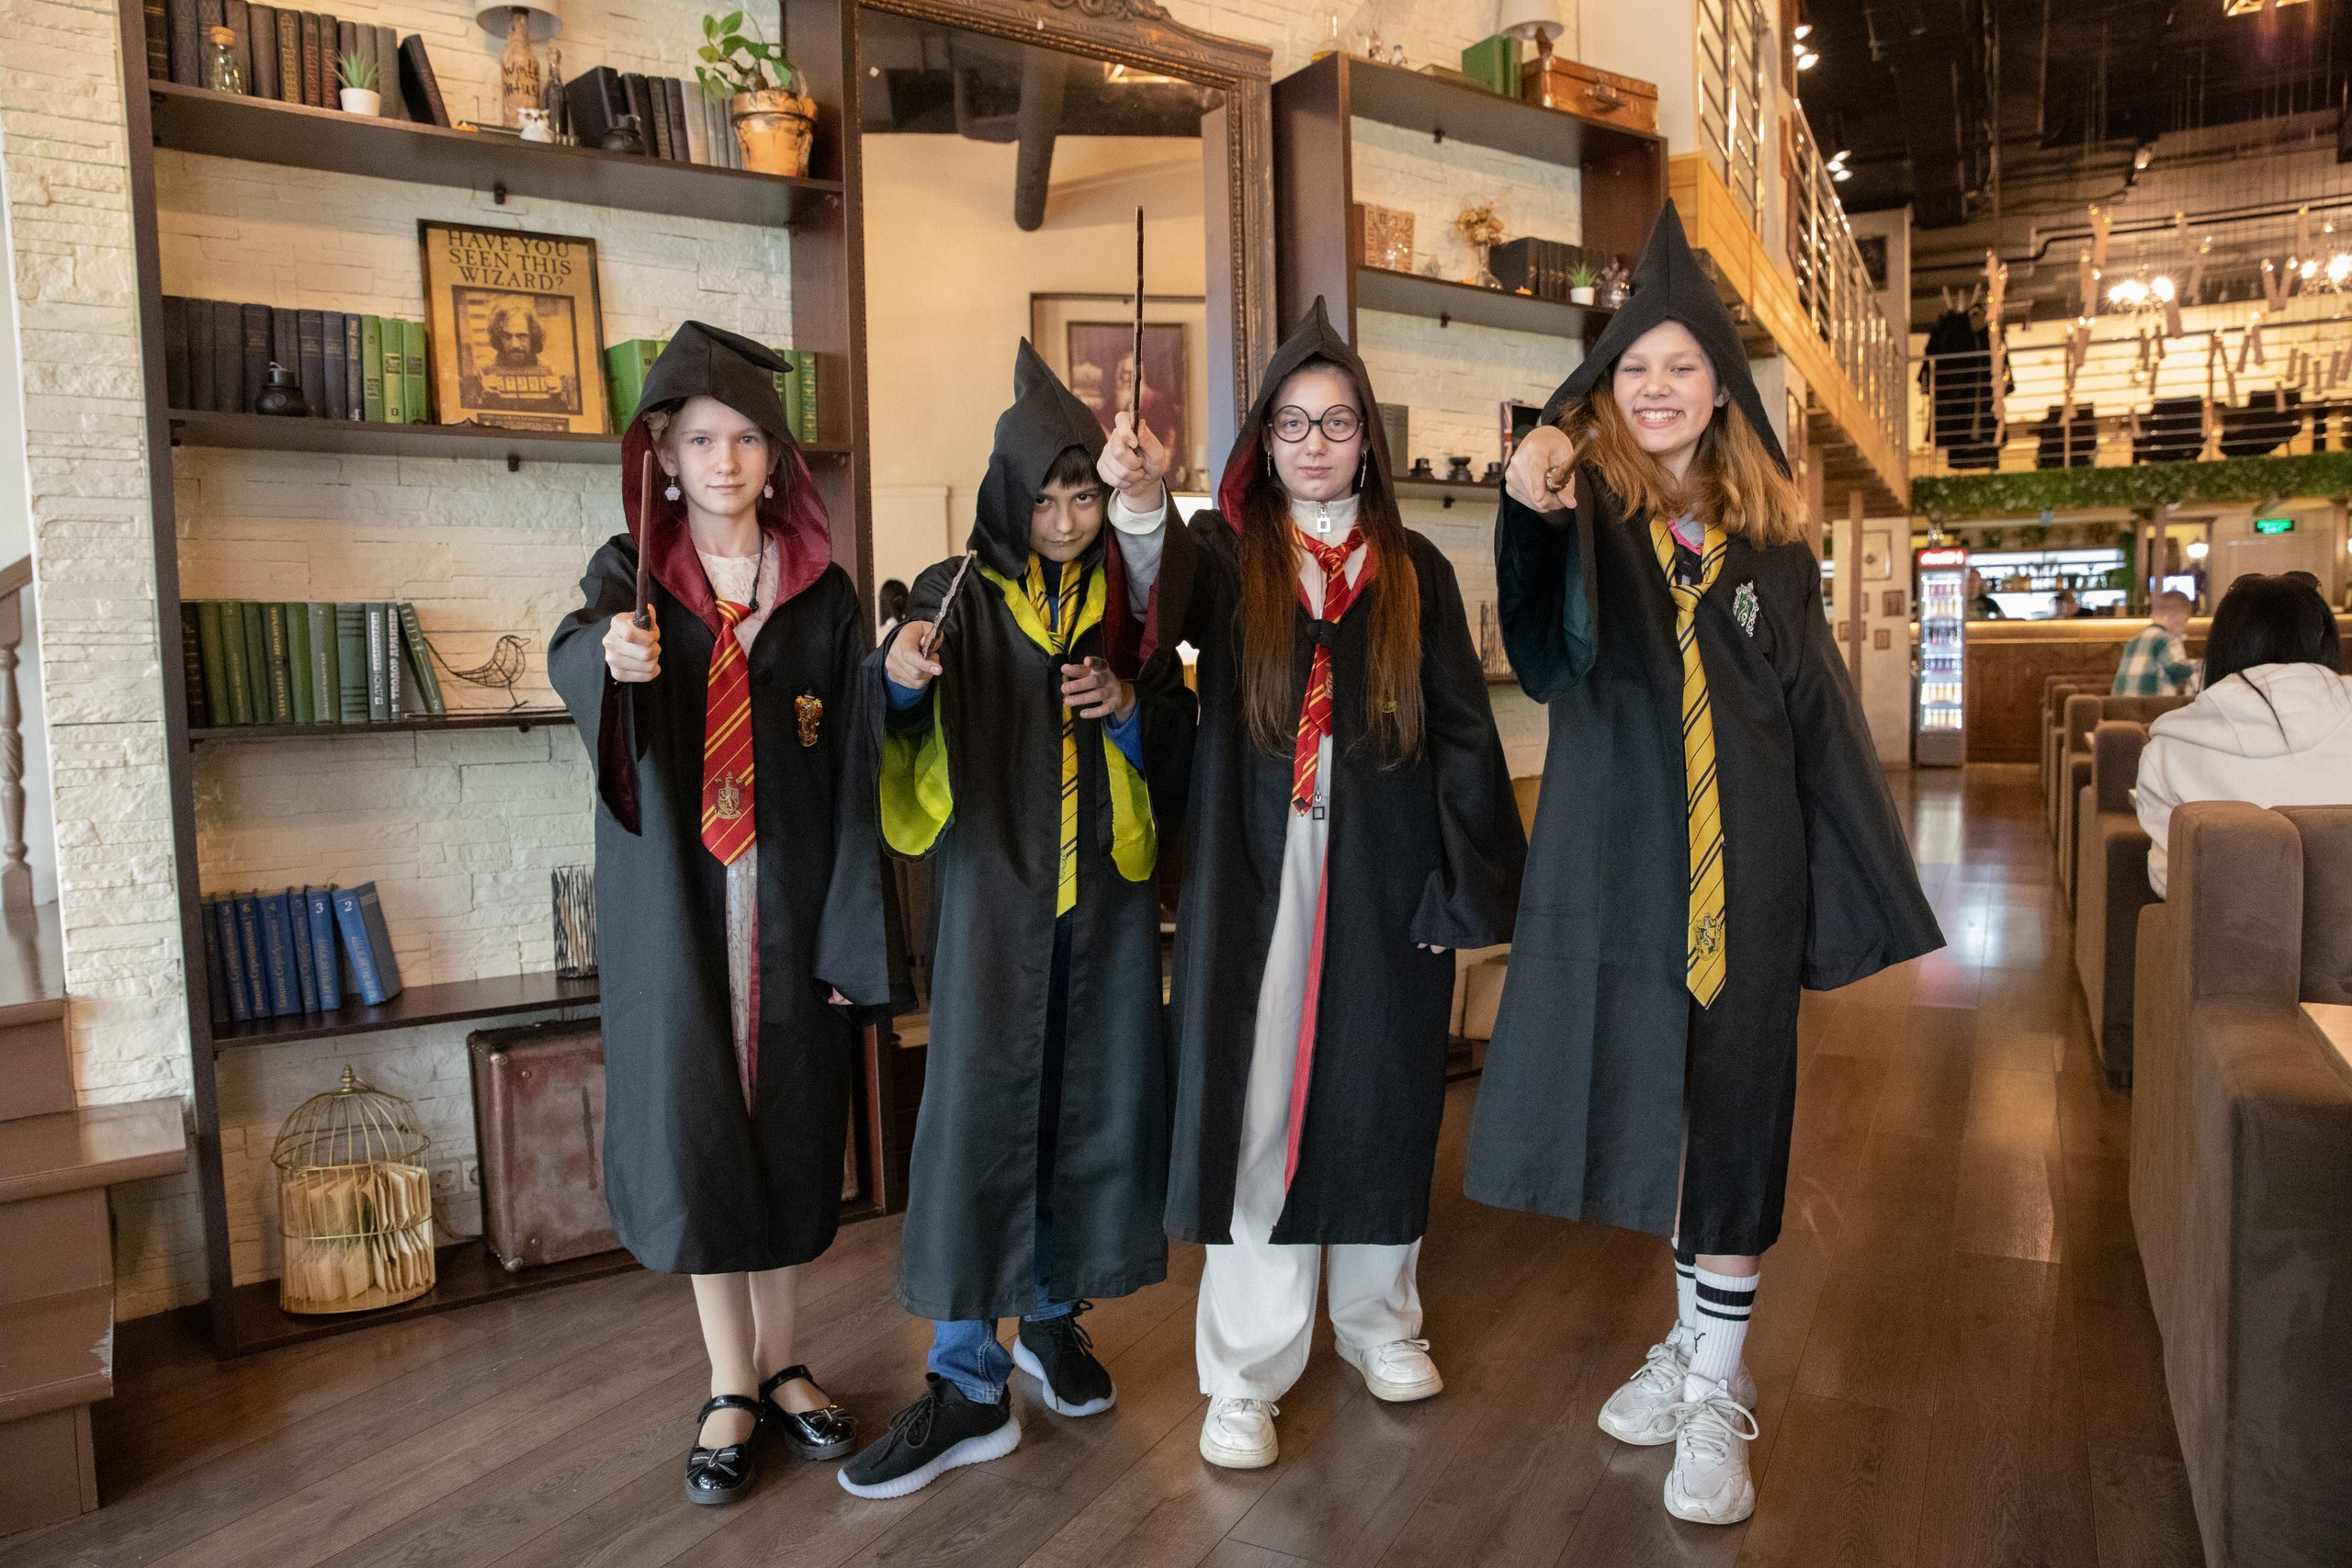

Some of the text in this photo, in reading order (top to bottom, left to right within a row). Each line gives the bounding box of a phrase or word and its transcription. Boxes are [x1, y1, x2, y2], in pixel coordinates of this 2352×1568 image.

[447, 230, 570, 258] HAVE YOU
[448, 248, 572, 276] SEEN THIS
[459, 266, 564, 291] WIZARD?
[389, 608, 400, 700] ТЕОДОР ДРАЙЗЕР
[315, 902, 324, 914] 3
[345, 900, 353, 912] 2
